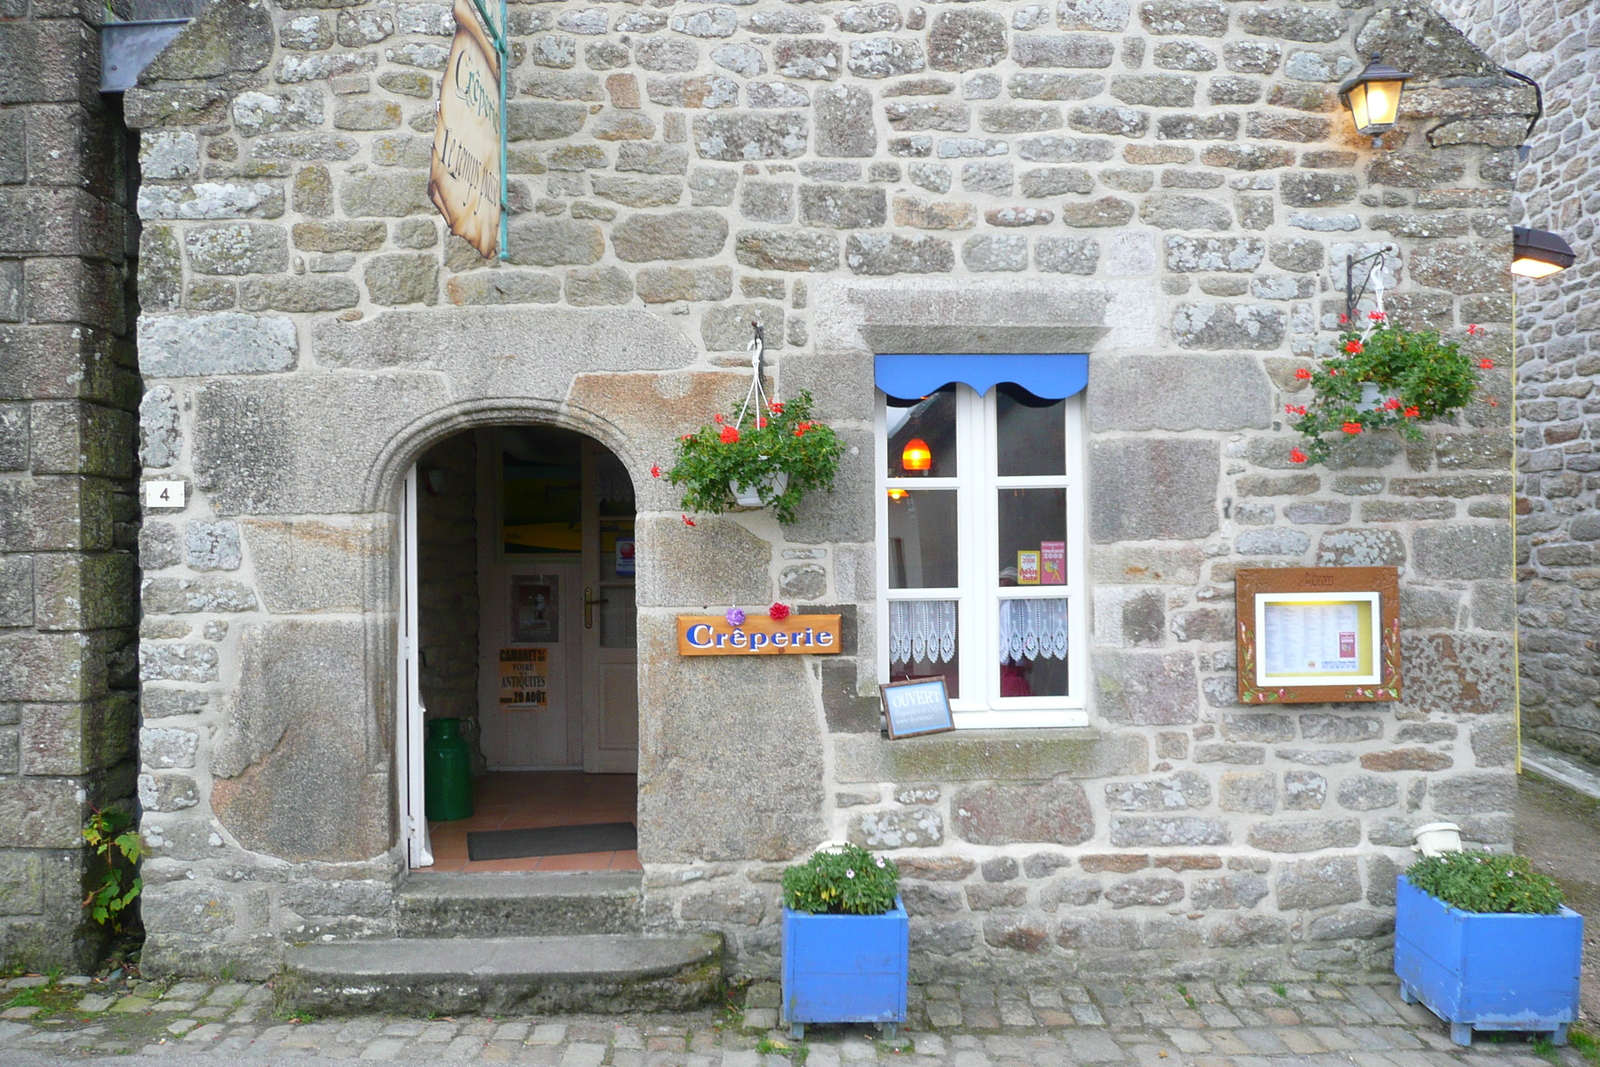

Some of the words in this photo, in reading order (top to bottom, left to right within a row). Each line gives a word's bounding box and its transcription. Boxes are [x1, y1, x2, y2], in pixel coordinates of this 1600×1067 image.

[160, 487, 170, 502] 4
[686, 623, 834, 652] Crêperie
[500, 649, 536, 661] CAMARET
[512, 663, 534, 671] FOIRE
[501, 674, 546, 689] ANTIQUITÉS
[513, 691, 524, 703] 20
[525, 689, 546, 703] AOÛT
[892, 690, 941, 708] OUVERT
